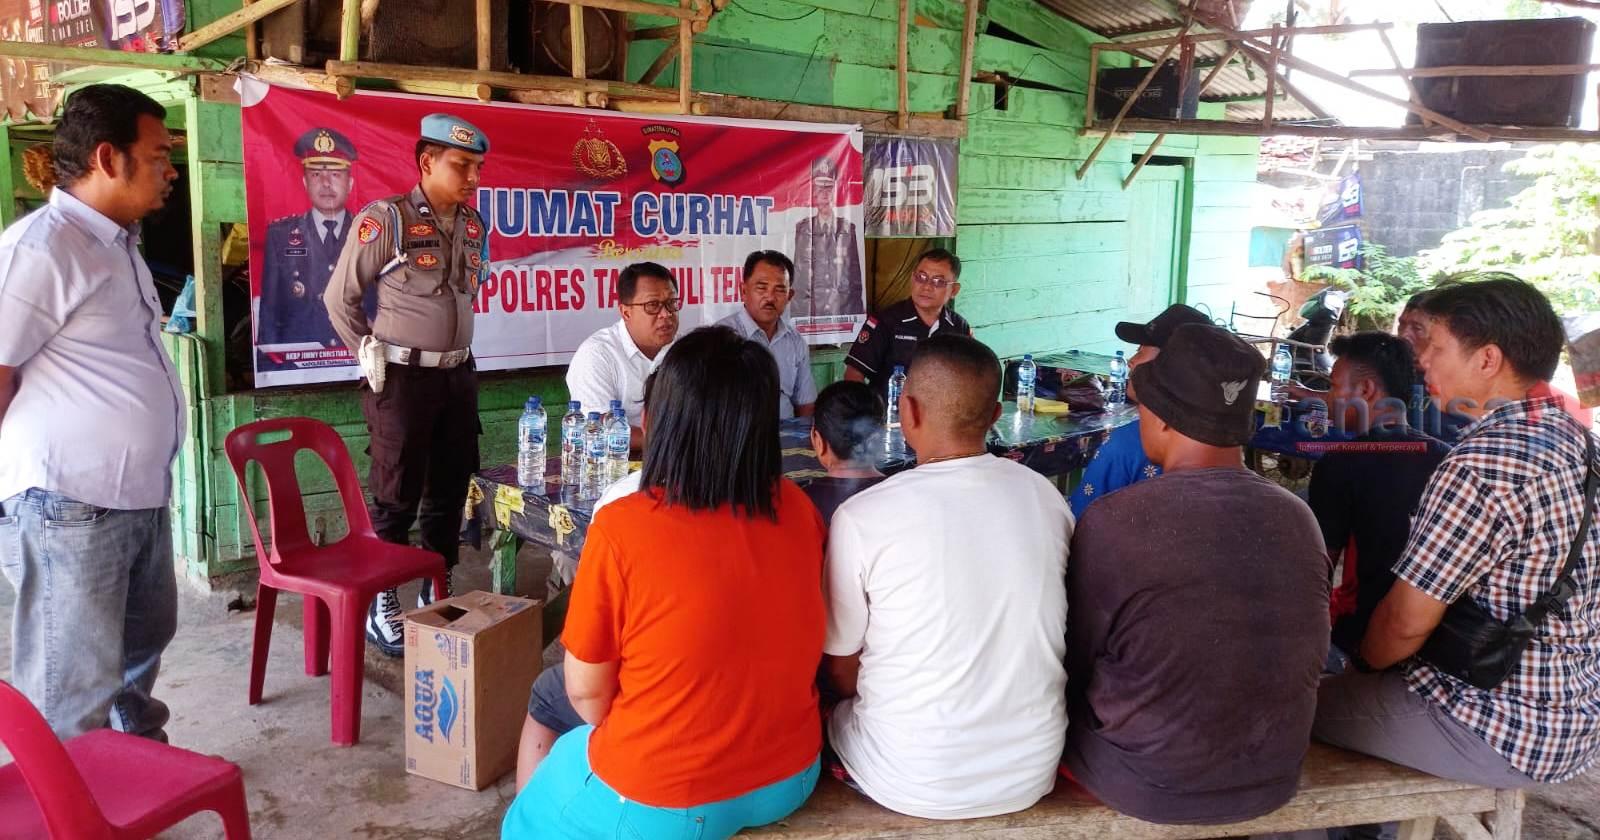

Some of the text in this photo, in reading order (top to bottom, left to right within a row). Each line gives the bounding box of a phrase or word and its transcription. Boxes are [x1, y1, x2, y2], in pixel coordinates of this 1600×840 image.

[477, 188, 774, 239] JUMAT CURHAT
[711, 266, 745, 304] TEN
[414, 667, 438, 744] AQUA
